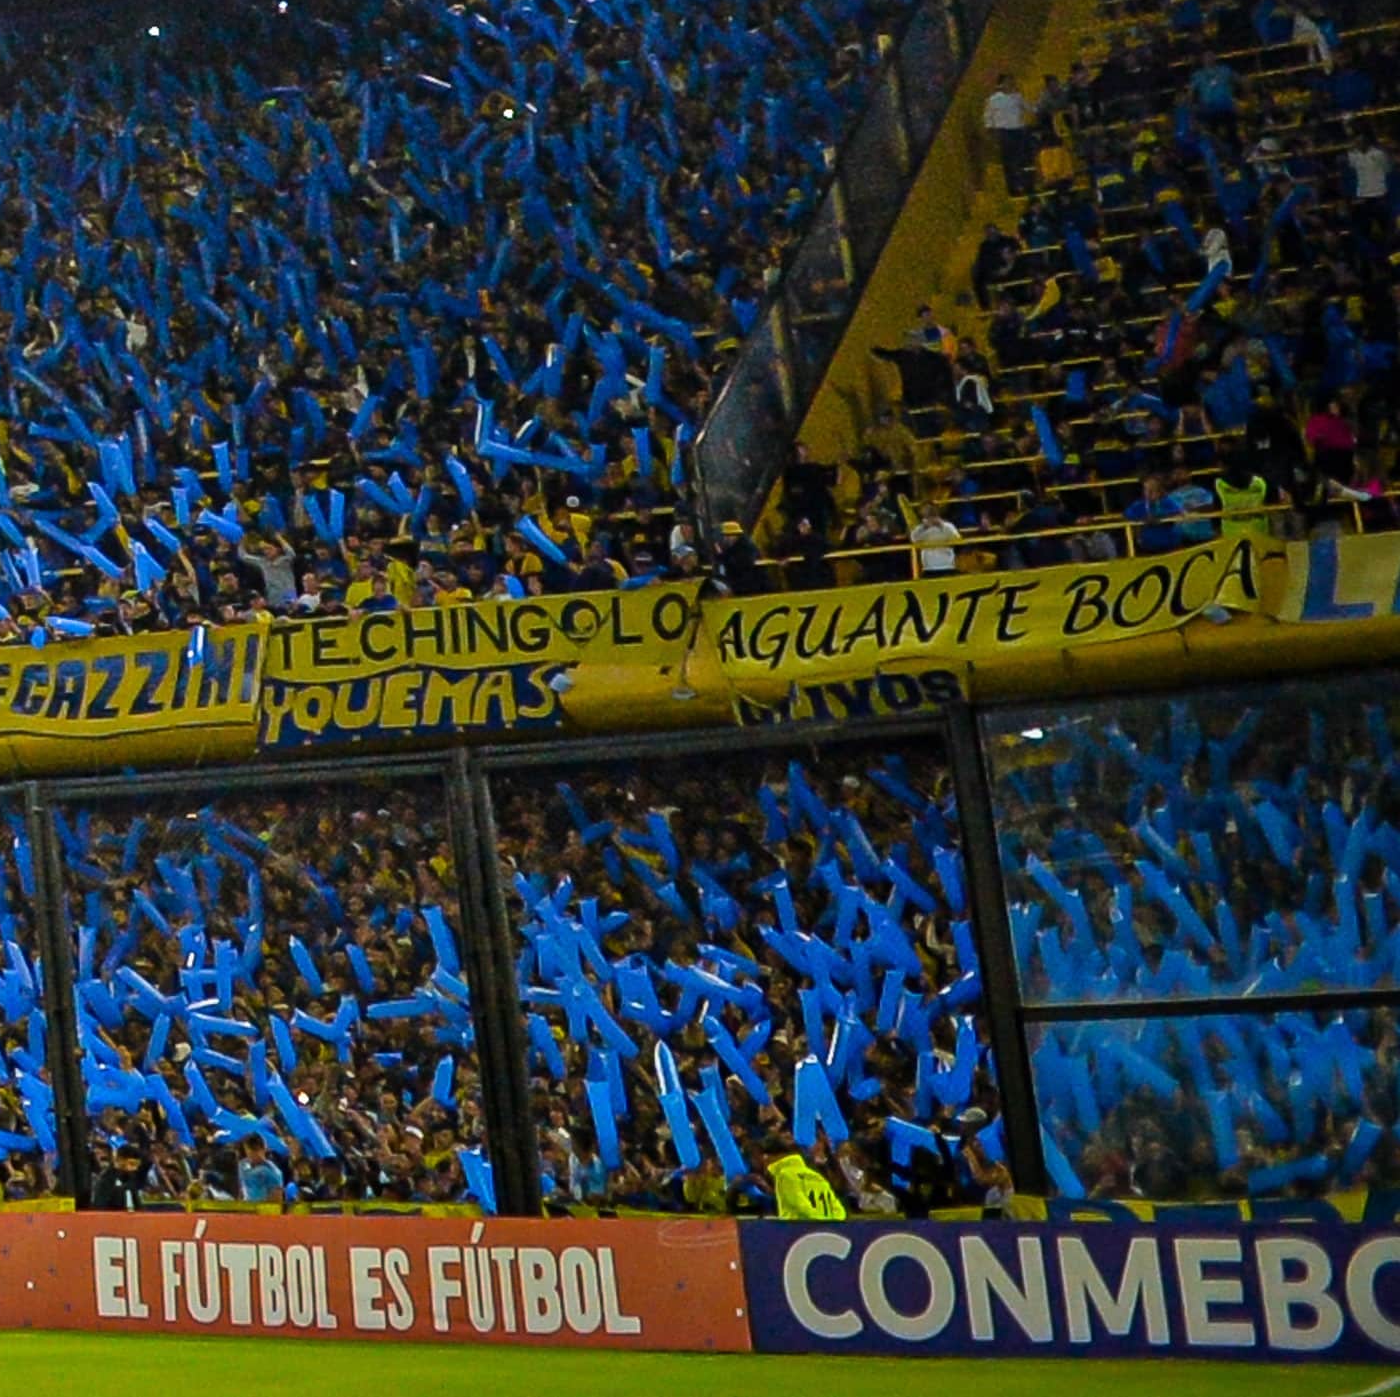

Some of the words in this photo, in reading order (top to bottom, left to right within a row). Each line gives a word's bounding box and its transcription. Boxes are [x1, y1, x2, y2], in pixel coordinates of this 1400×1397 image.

[717, 578, 1039, 670] AGUANTE
[1062, 538, 1259, 636] BOCA
[93, 1236, 149, 1318] EL
[160, 1219, 338, 1329] FÚTBOL
[349, 1246, 415, 1332] ES
[428, 1221, 642, 1335] FÚTBOL
